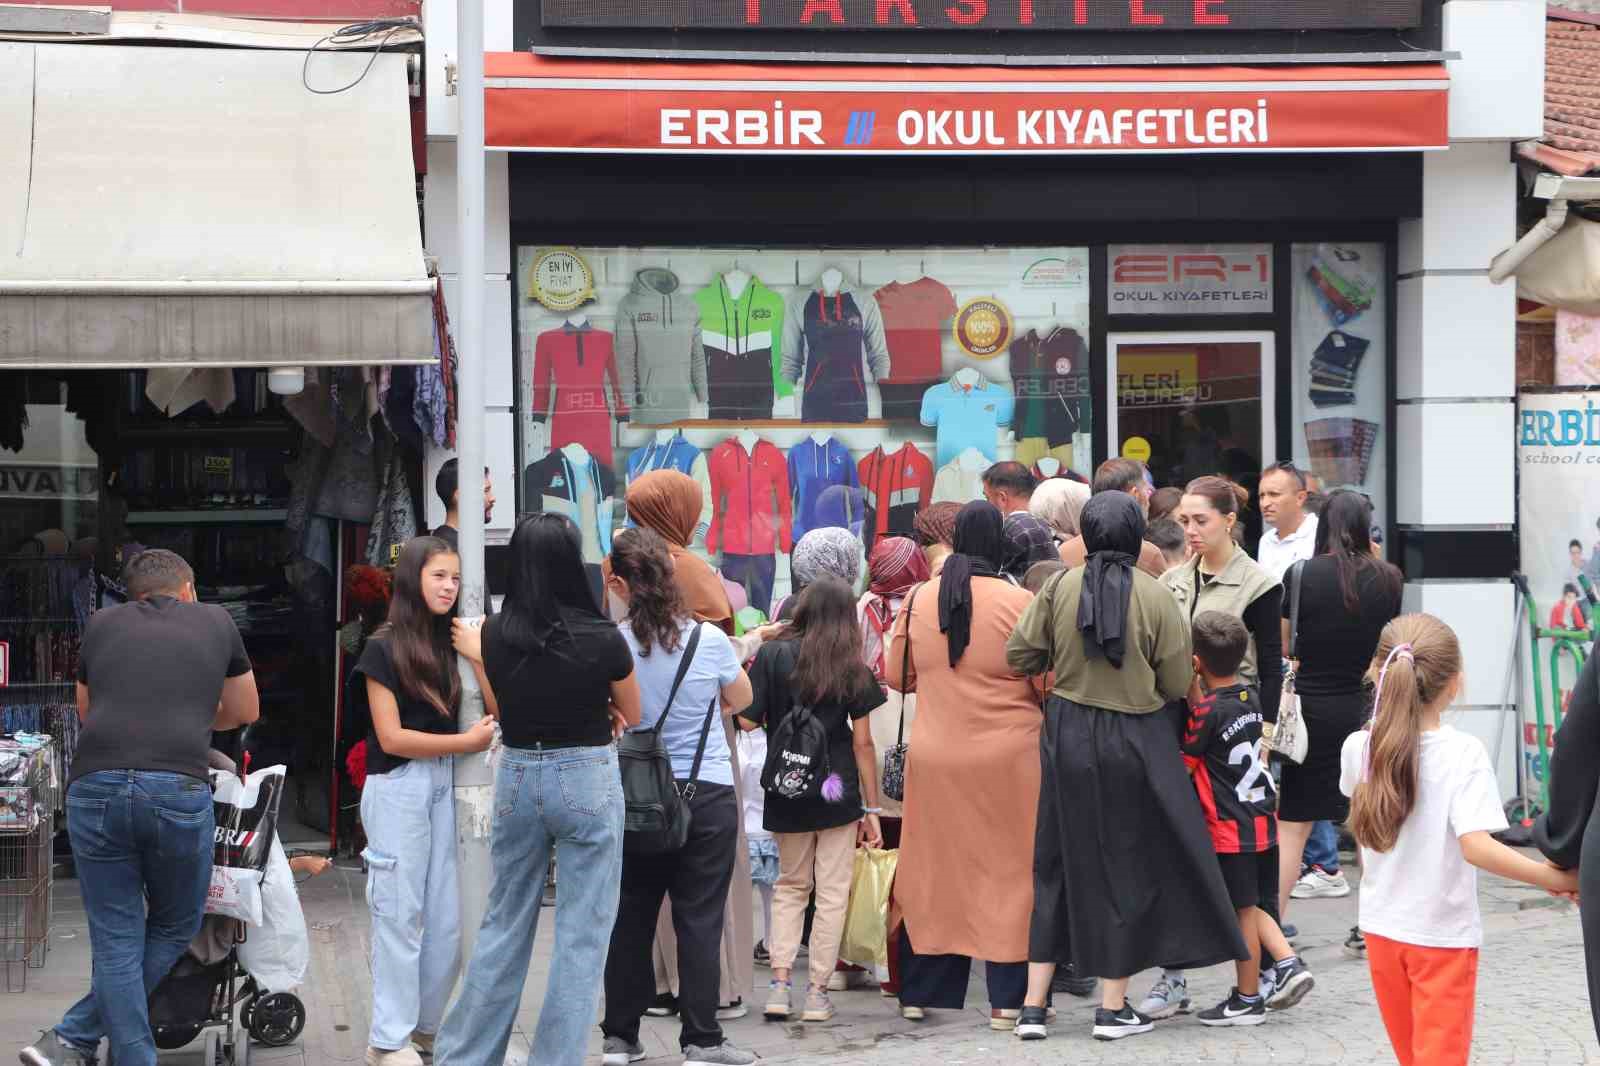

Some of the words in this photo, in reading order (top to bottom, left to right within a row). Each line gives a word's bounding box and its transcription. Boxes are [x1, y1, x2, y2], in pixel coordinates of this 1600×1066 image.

[660, 100, 825, 145] ERBİR
[897, 109, 1005, 146] OKUL
[1017, 99, 1268, 145] KIYAFETLERİ
[1113, 254, 1268, 283] ER-1
[1113, 291, 1158, 301] OKUL
[1525, 451, 1582, 464] school
